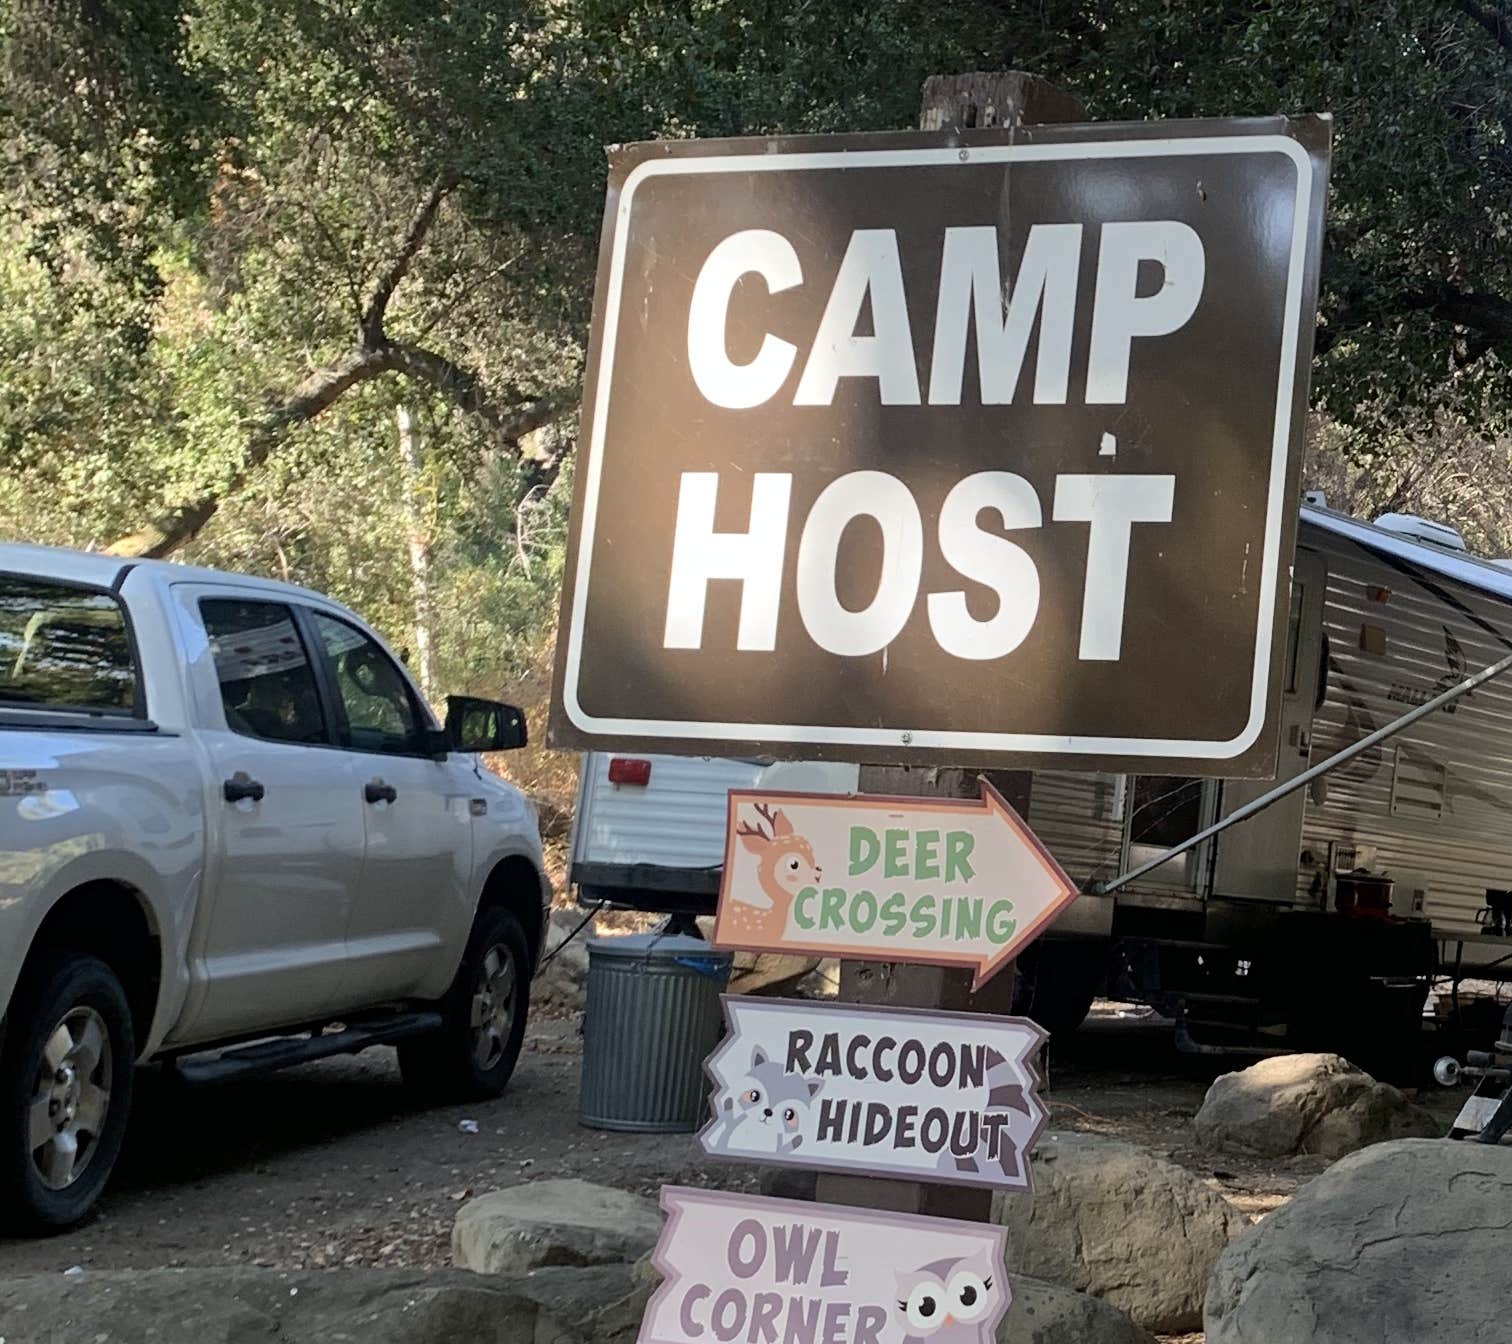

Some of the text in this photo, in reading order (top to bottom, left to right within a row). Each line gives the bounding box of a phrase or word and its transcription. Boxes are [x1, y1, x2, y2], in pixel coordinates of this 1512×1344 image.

[687, 220, 1206, 409] CAMP
[663, 470, 1176, 661] HOST
[847, 825, 976, 884] DEER
[792, 887, 1017, 945] CROSSING
[784, 1029, 986, 1088] RACCOON
[816, 1098, 1009, 1160] HIDEOUT
[727, 1218, 849, 1288] OWL
